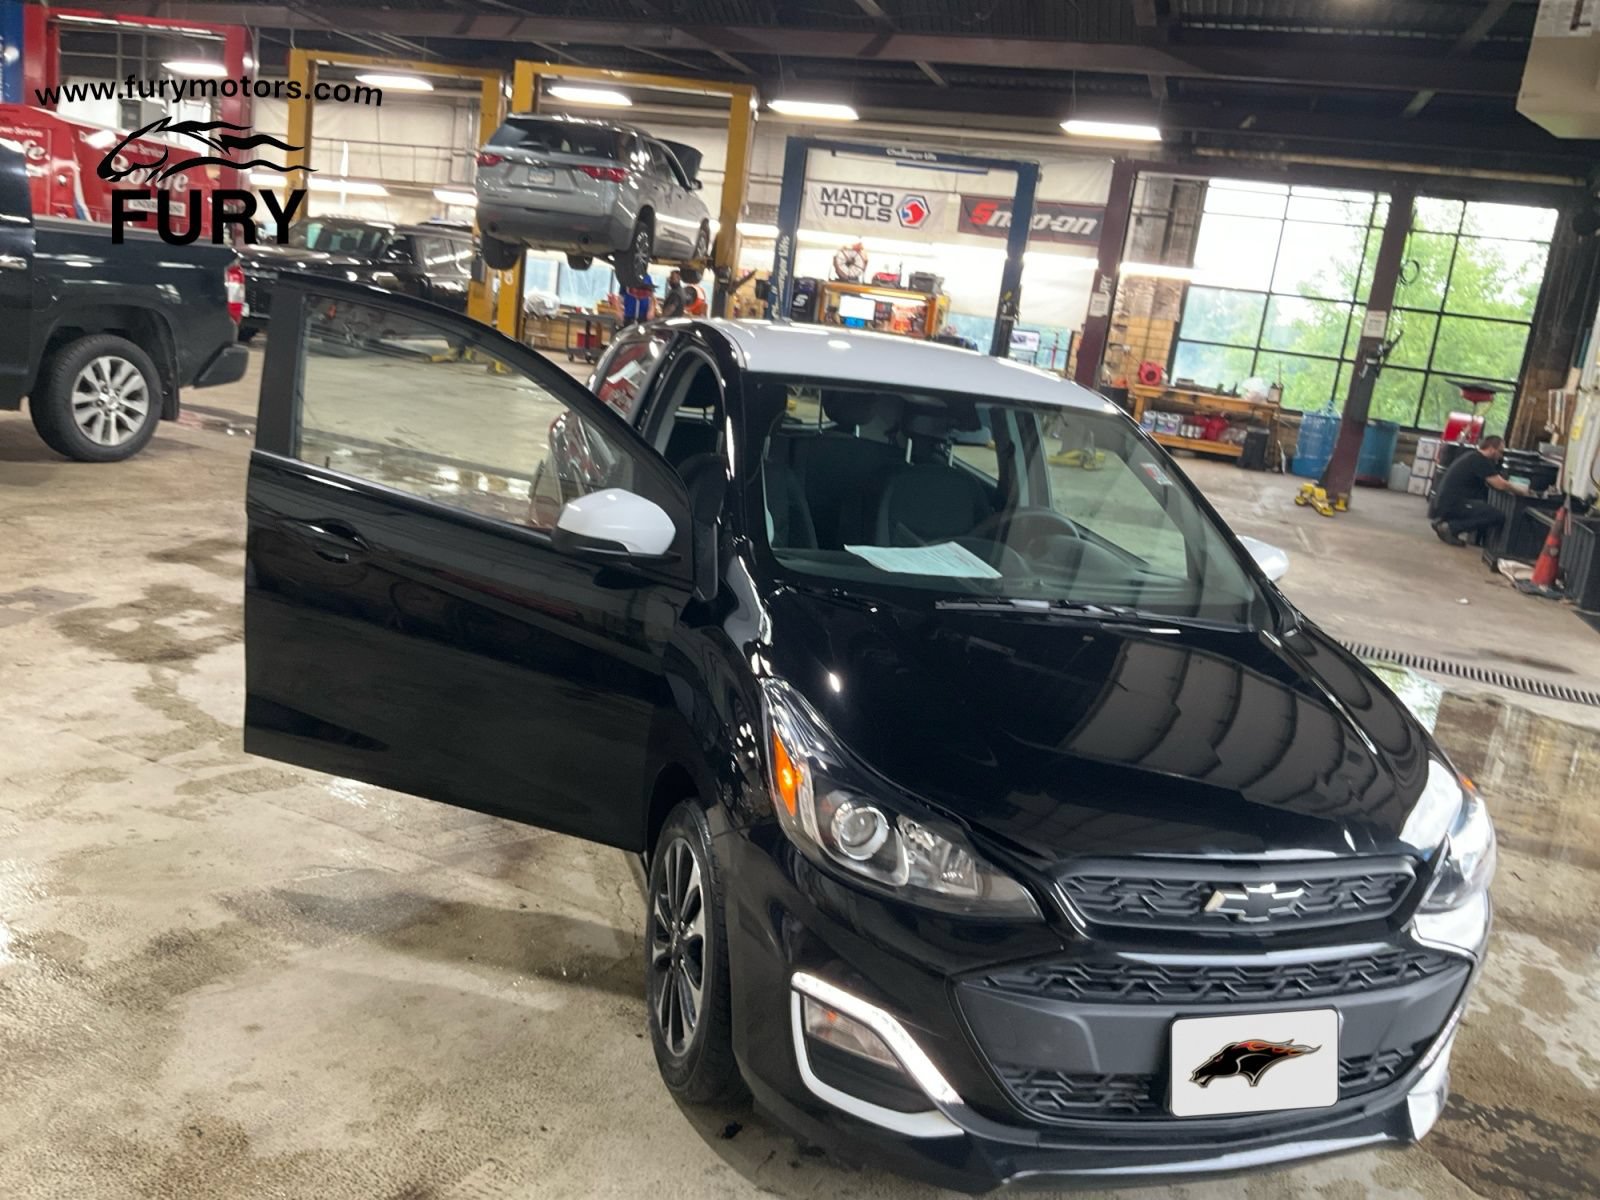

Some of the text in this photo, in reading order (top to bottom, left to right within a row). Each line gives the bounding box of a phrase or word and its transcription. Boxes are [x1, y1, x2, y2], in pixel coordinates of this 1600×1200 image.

[820, 187, 895, 208] MATCO
[819, 201, 893, 223] TOOLS
[970, 201, 1097, 235] Snp-on
